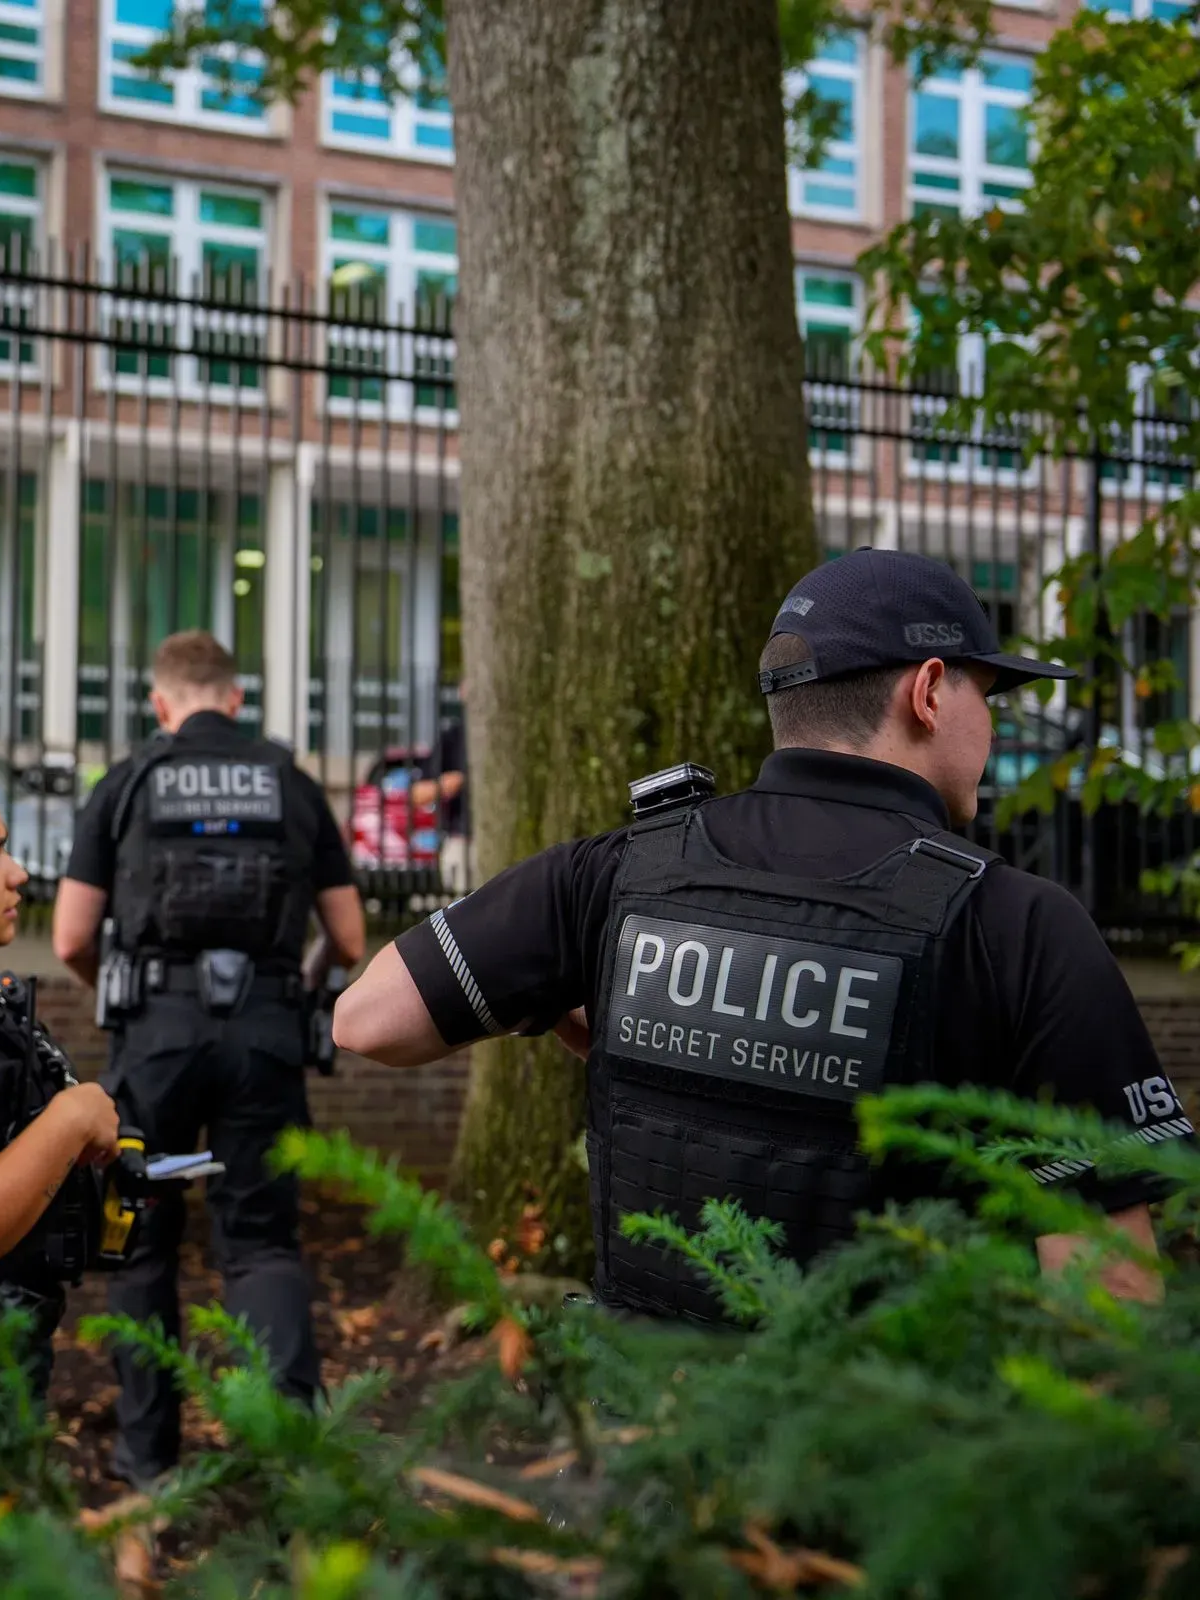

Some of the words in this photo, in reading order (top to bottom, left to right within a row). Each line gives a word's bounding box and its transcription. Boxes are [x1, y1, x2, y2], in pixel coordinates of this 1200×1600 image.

[903, 622, 964, 646] USSS
[155, 764, 273, 797] POLICE
[626, 931, 879, 1039] POLICE
[618, 1015, 721, 1060] SECRET
[730, 1037, 863, 1089] SERVICE
[1123, 1075, 1184, 1125] US
